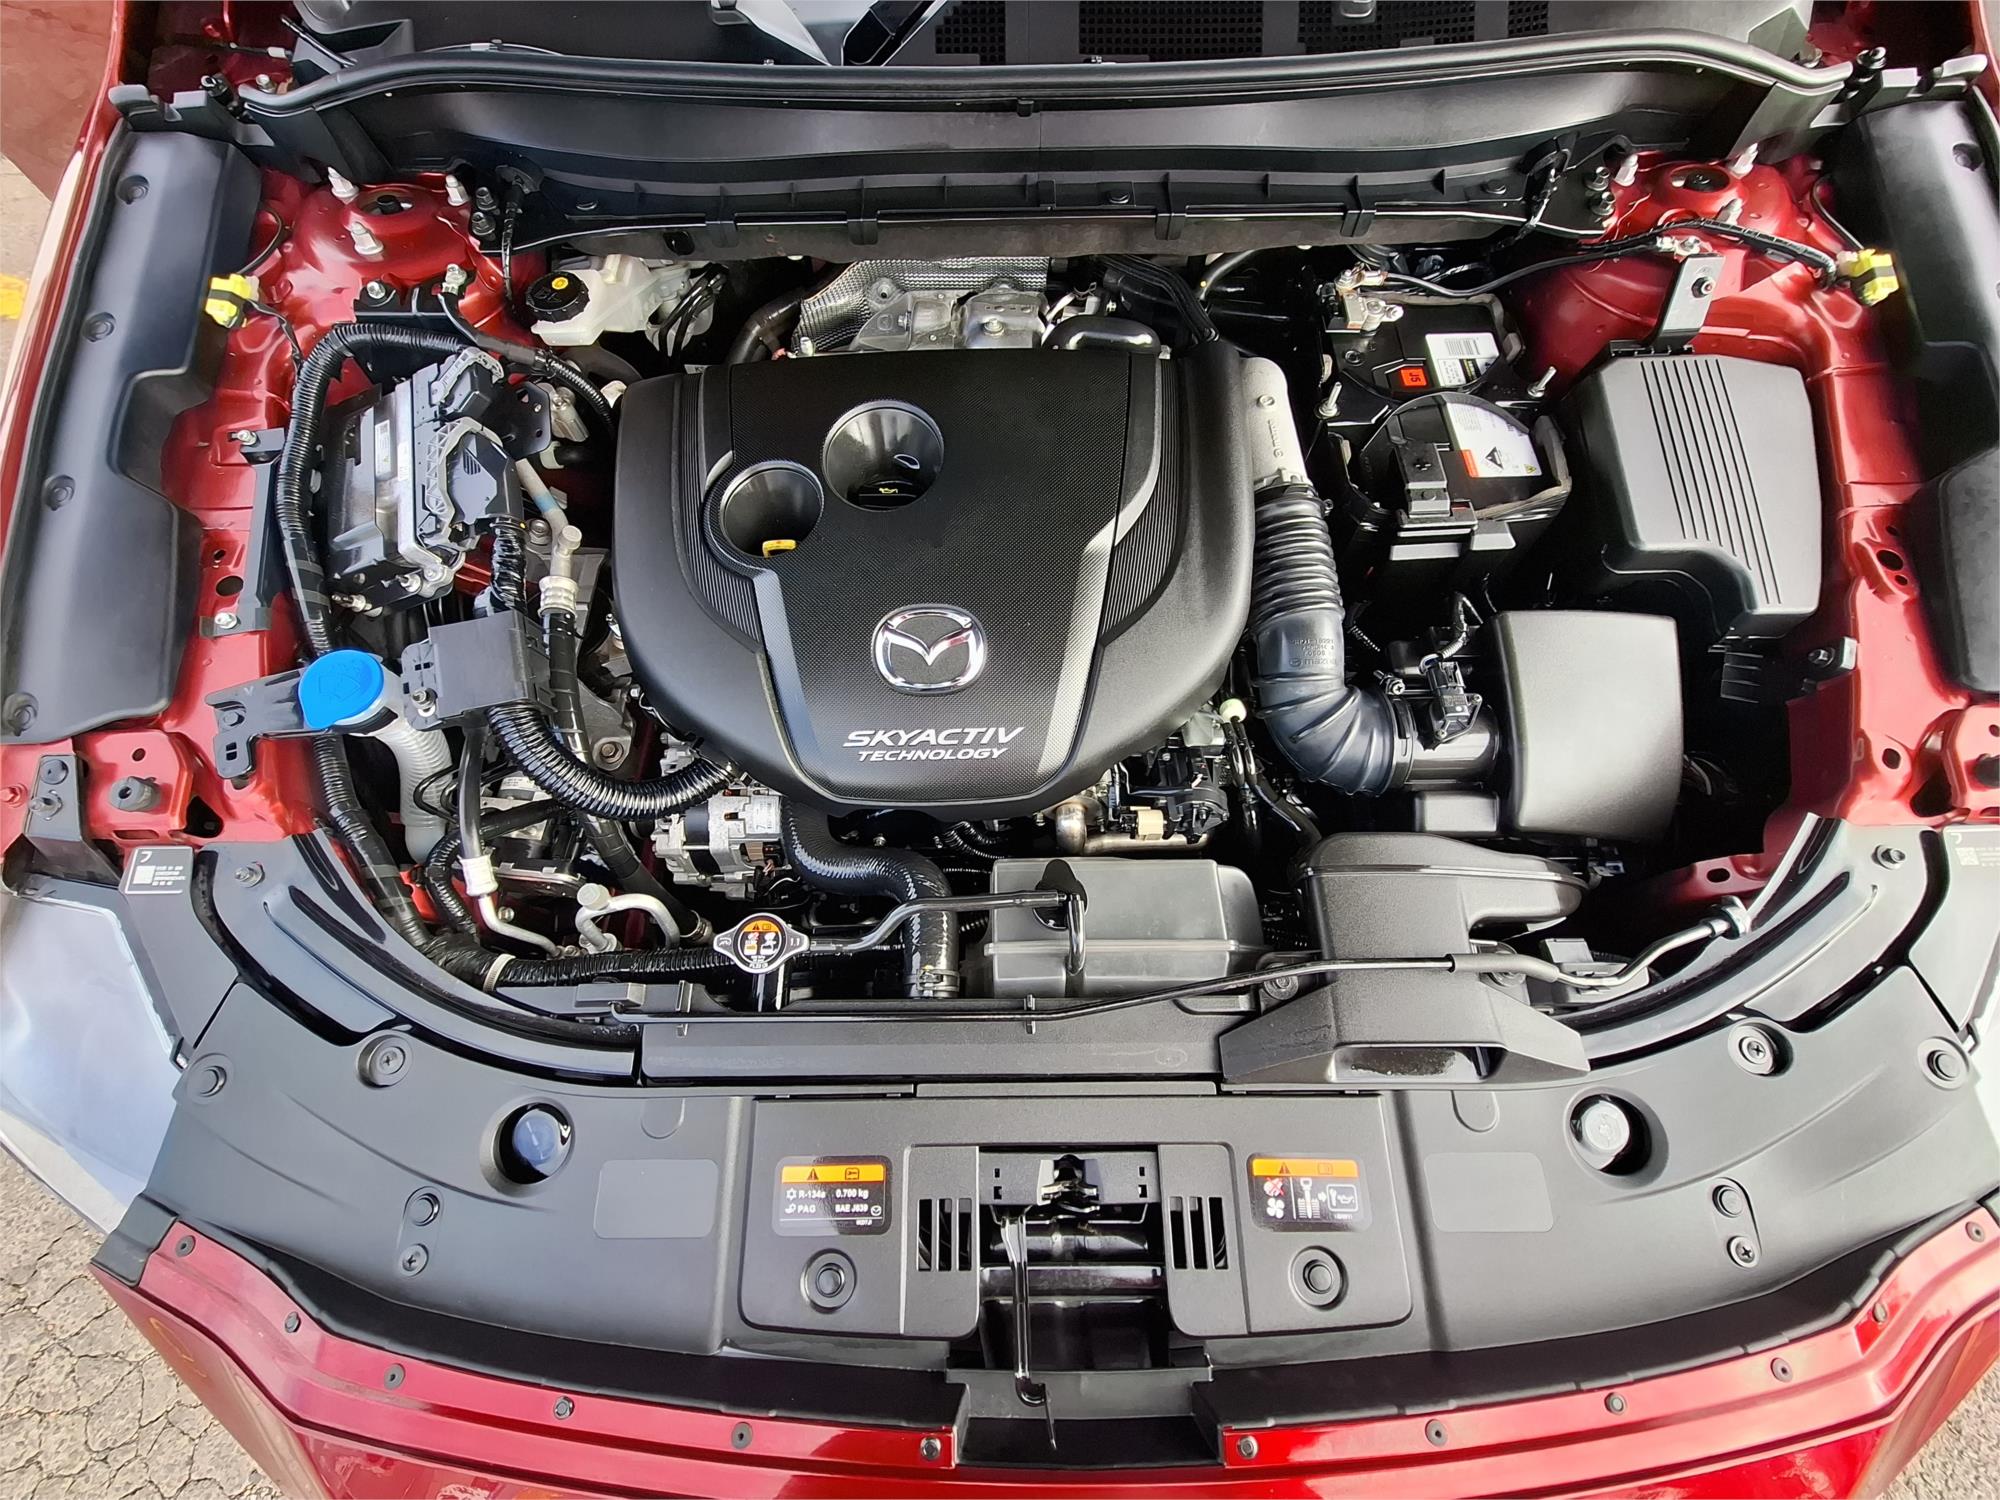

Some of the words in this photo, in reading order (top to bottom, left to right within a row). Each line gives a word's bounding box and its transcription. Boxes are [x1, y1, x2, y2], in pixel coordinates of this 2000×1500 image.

[842, 726, 1026, 747] SKYACTIV
[857, 747, 1009, 762] TECHNOLOGY
[798, 1189, 826, 1199] R-134a
[835, 1188, 857, 1199] 0.700
[858, 1188, 869, 1200] kg
[797, 1204, 816, 1213] PAG
